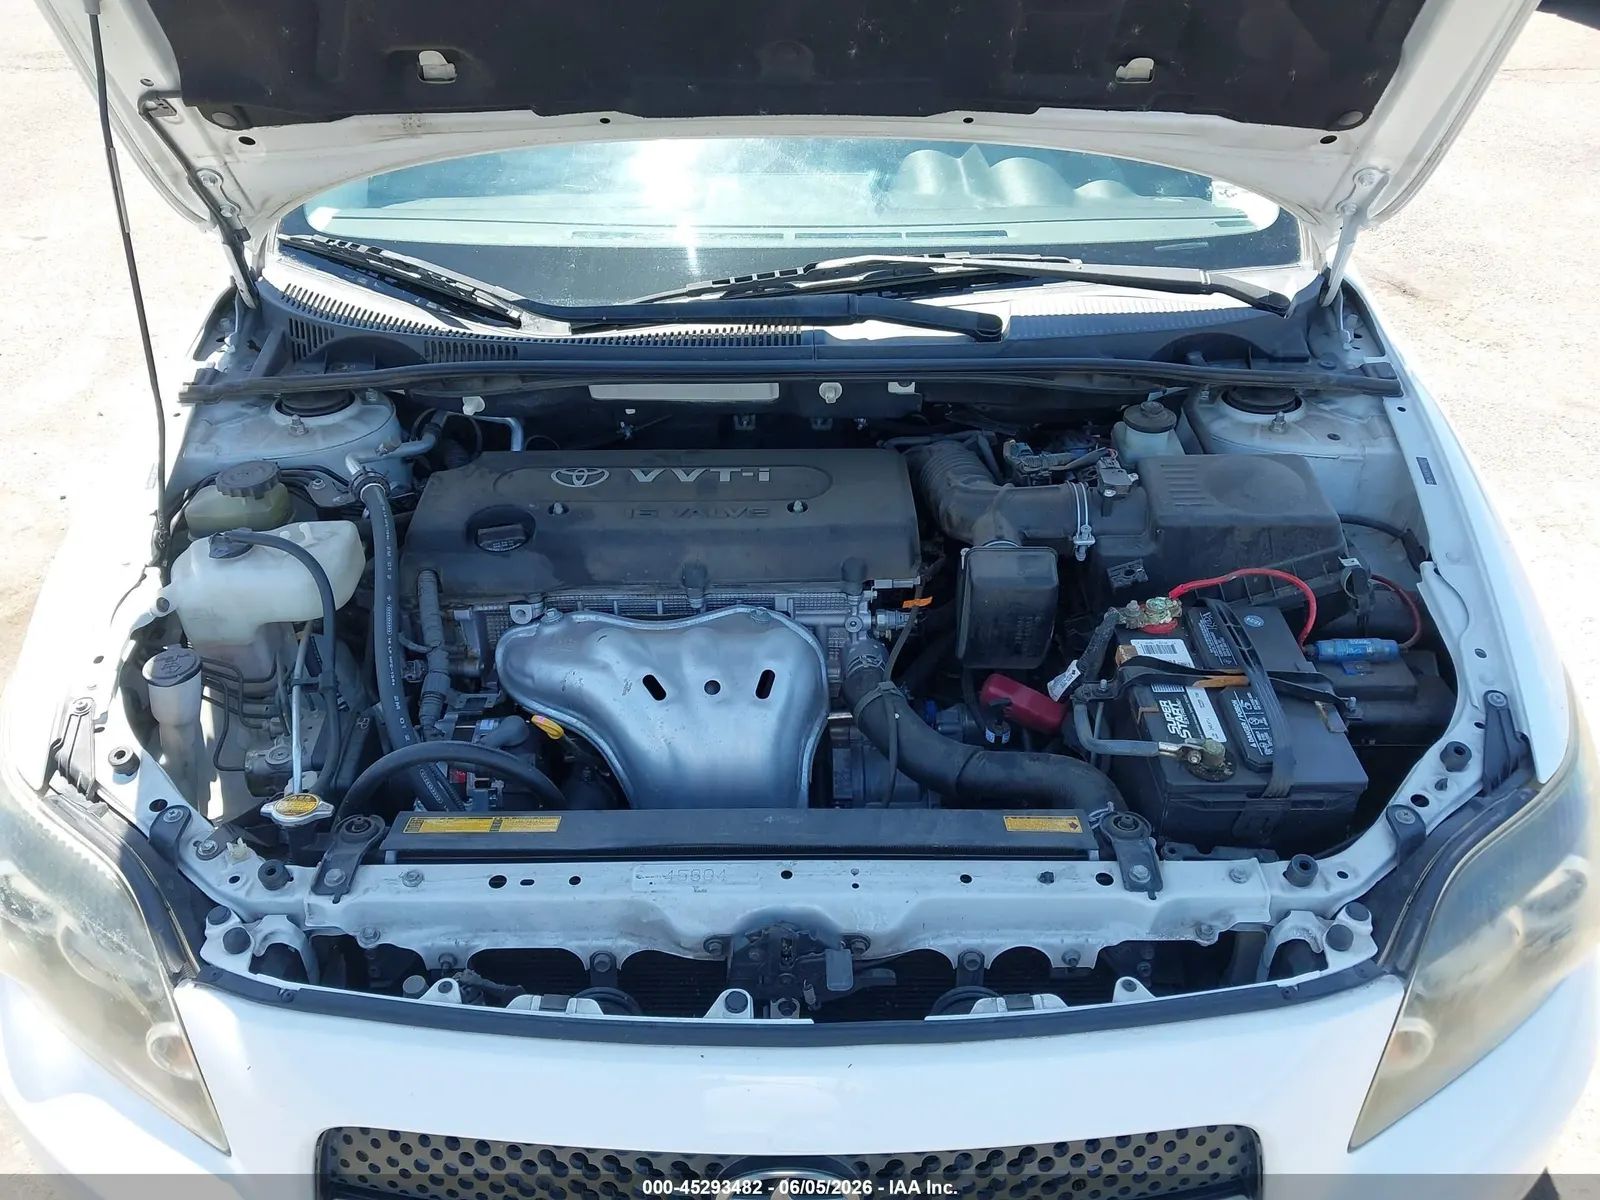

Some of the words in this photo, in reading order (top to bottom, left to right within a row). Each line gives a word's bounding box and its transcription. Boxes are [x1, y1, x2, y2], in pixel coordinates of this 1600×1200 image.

[629, 467, 770, 482] VVT-i
[675, 507, 769, 519] VALVE
[1159, 700, 1180, 735] SUPER
[1168, 700, 1192, 739] START
